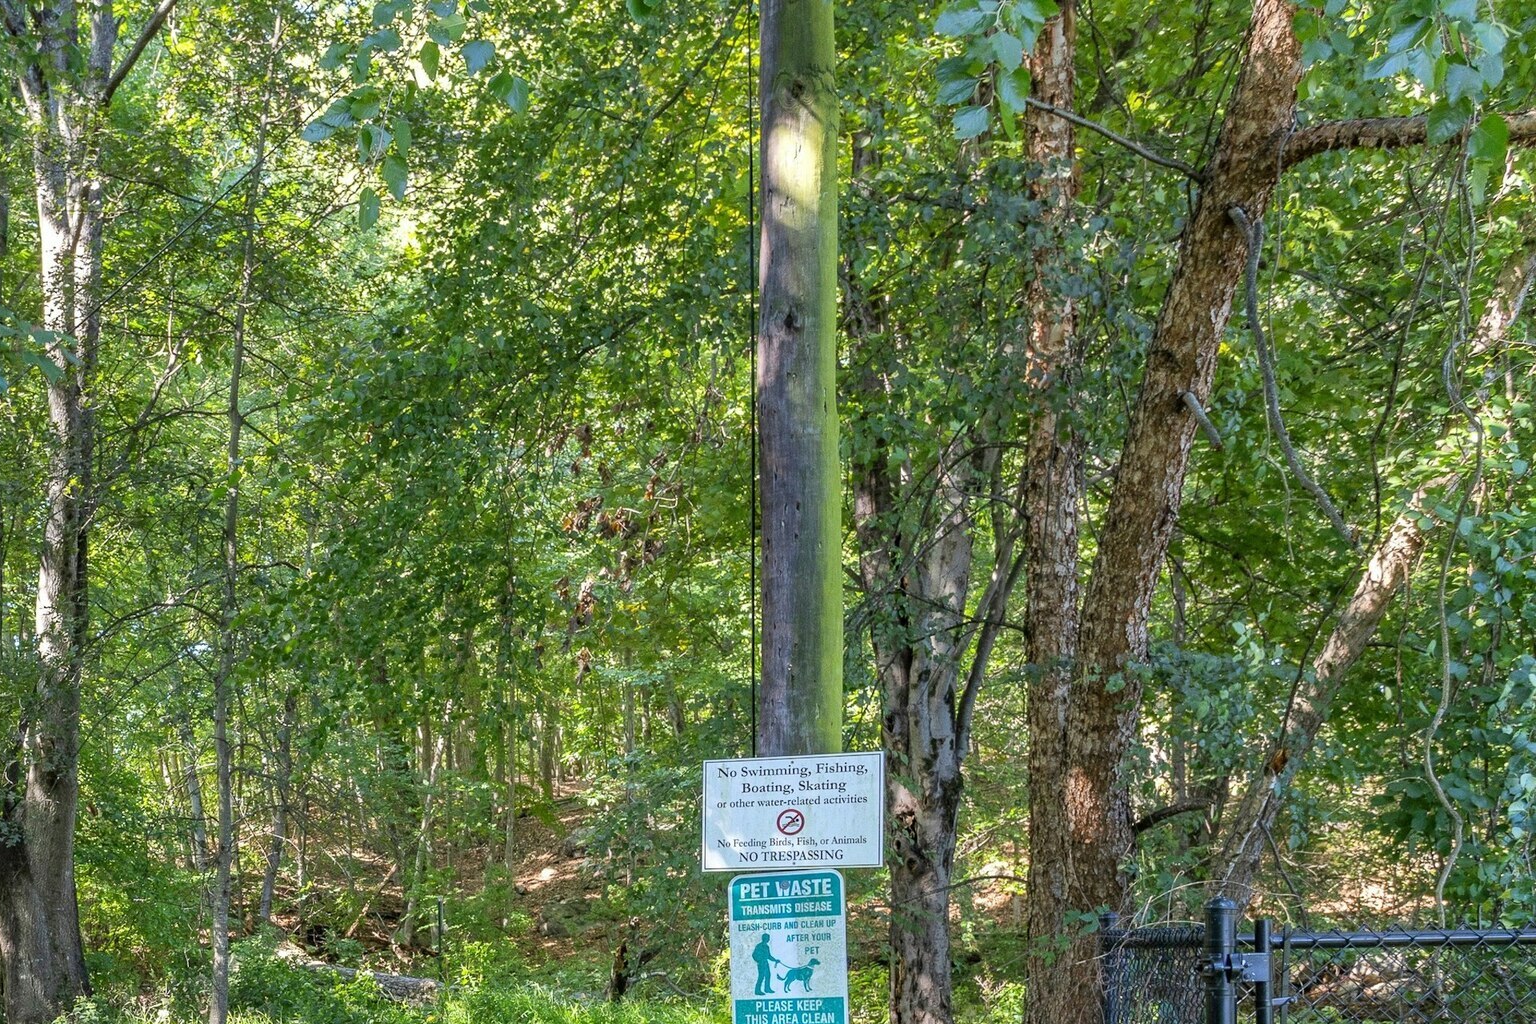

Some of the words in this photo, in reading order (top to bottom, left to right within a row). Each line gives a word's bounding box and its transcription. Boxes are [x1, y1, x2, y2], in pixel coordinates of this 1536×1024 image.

[717, 767, 737, 779] No
[741, 763, 812, 778] Swimming,
[815, 762, 868, 776] Fishing,
[742, 782, 794, 795] Boating,
[798, 780, 847, 793] Skating
[717, 801, 727, 809] or
[729, 798, 755, 808] other
[757, 796, 821, 807] water-related
[823, 794, 868, 805] activities
[717, 839, 731, 849] No
[733, 838, 767, 849] Feeding
[769, 837, 794, 847] Birds,
[796, 836, 818, 847] Fish,
[831, 835, 867, 845] Animals
[739, 851, 759, 863] NO
[762, 849, 844, 862] TRESPASSING
[740, 882, 770, 899] PET
[775, 878, 832, 897] WASTE
[741, 903, 792, 916] TRANSMITS
[794, 901, 832, 913] DISEASE
[738, 922, 782, 932] LEASH-CURB
[784, 921, 799, 930] AND
[800, 920, 824, 929] CLEAN
[826, 919, 836, 927] UP
[786, 933, 809, 942] AFTER
[811, 932, 831, 941] YOUR
[804, 946, 820, 955] PET
[755, 1000, 793, 1012] PLEASE
[796, 1000, 823, 1011] KEEP
[745, 1014, 769, 1024] THIS
[771, 1013, 799, 1024] AREA
[801, 1012, 835, 1024] CLEAN
